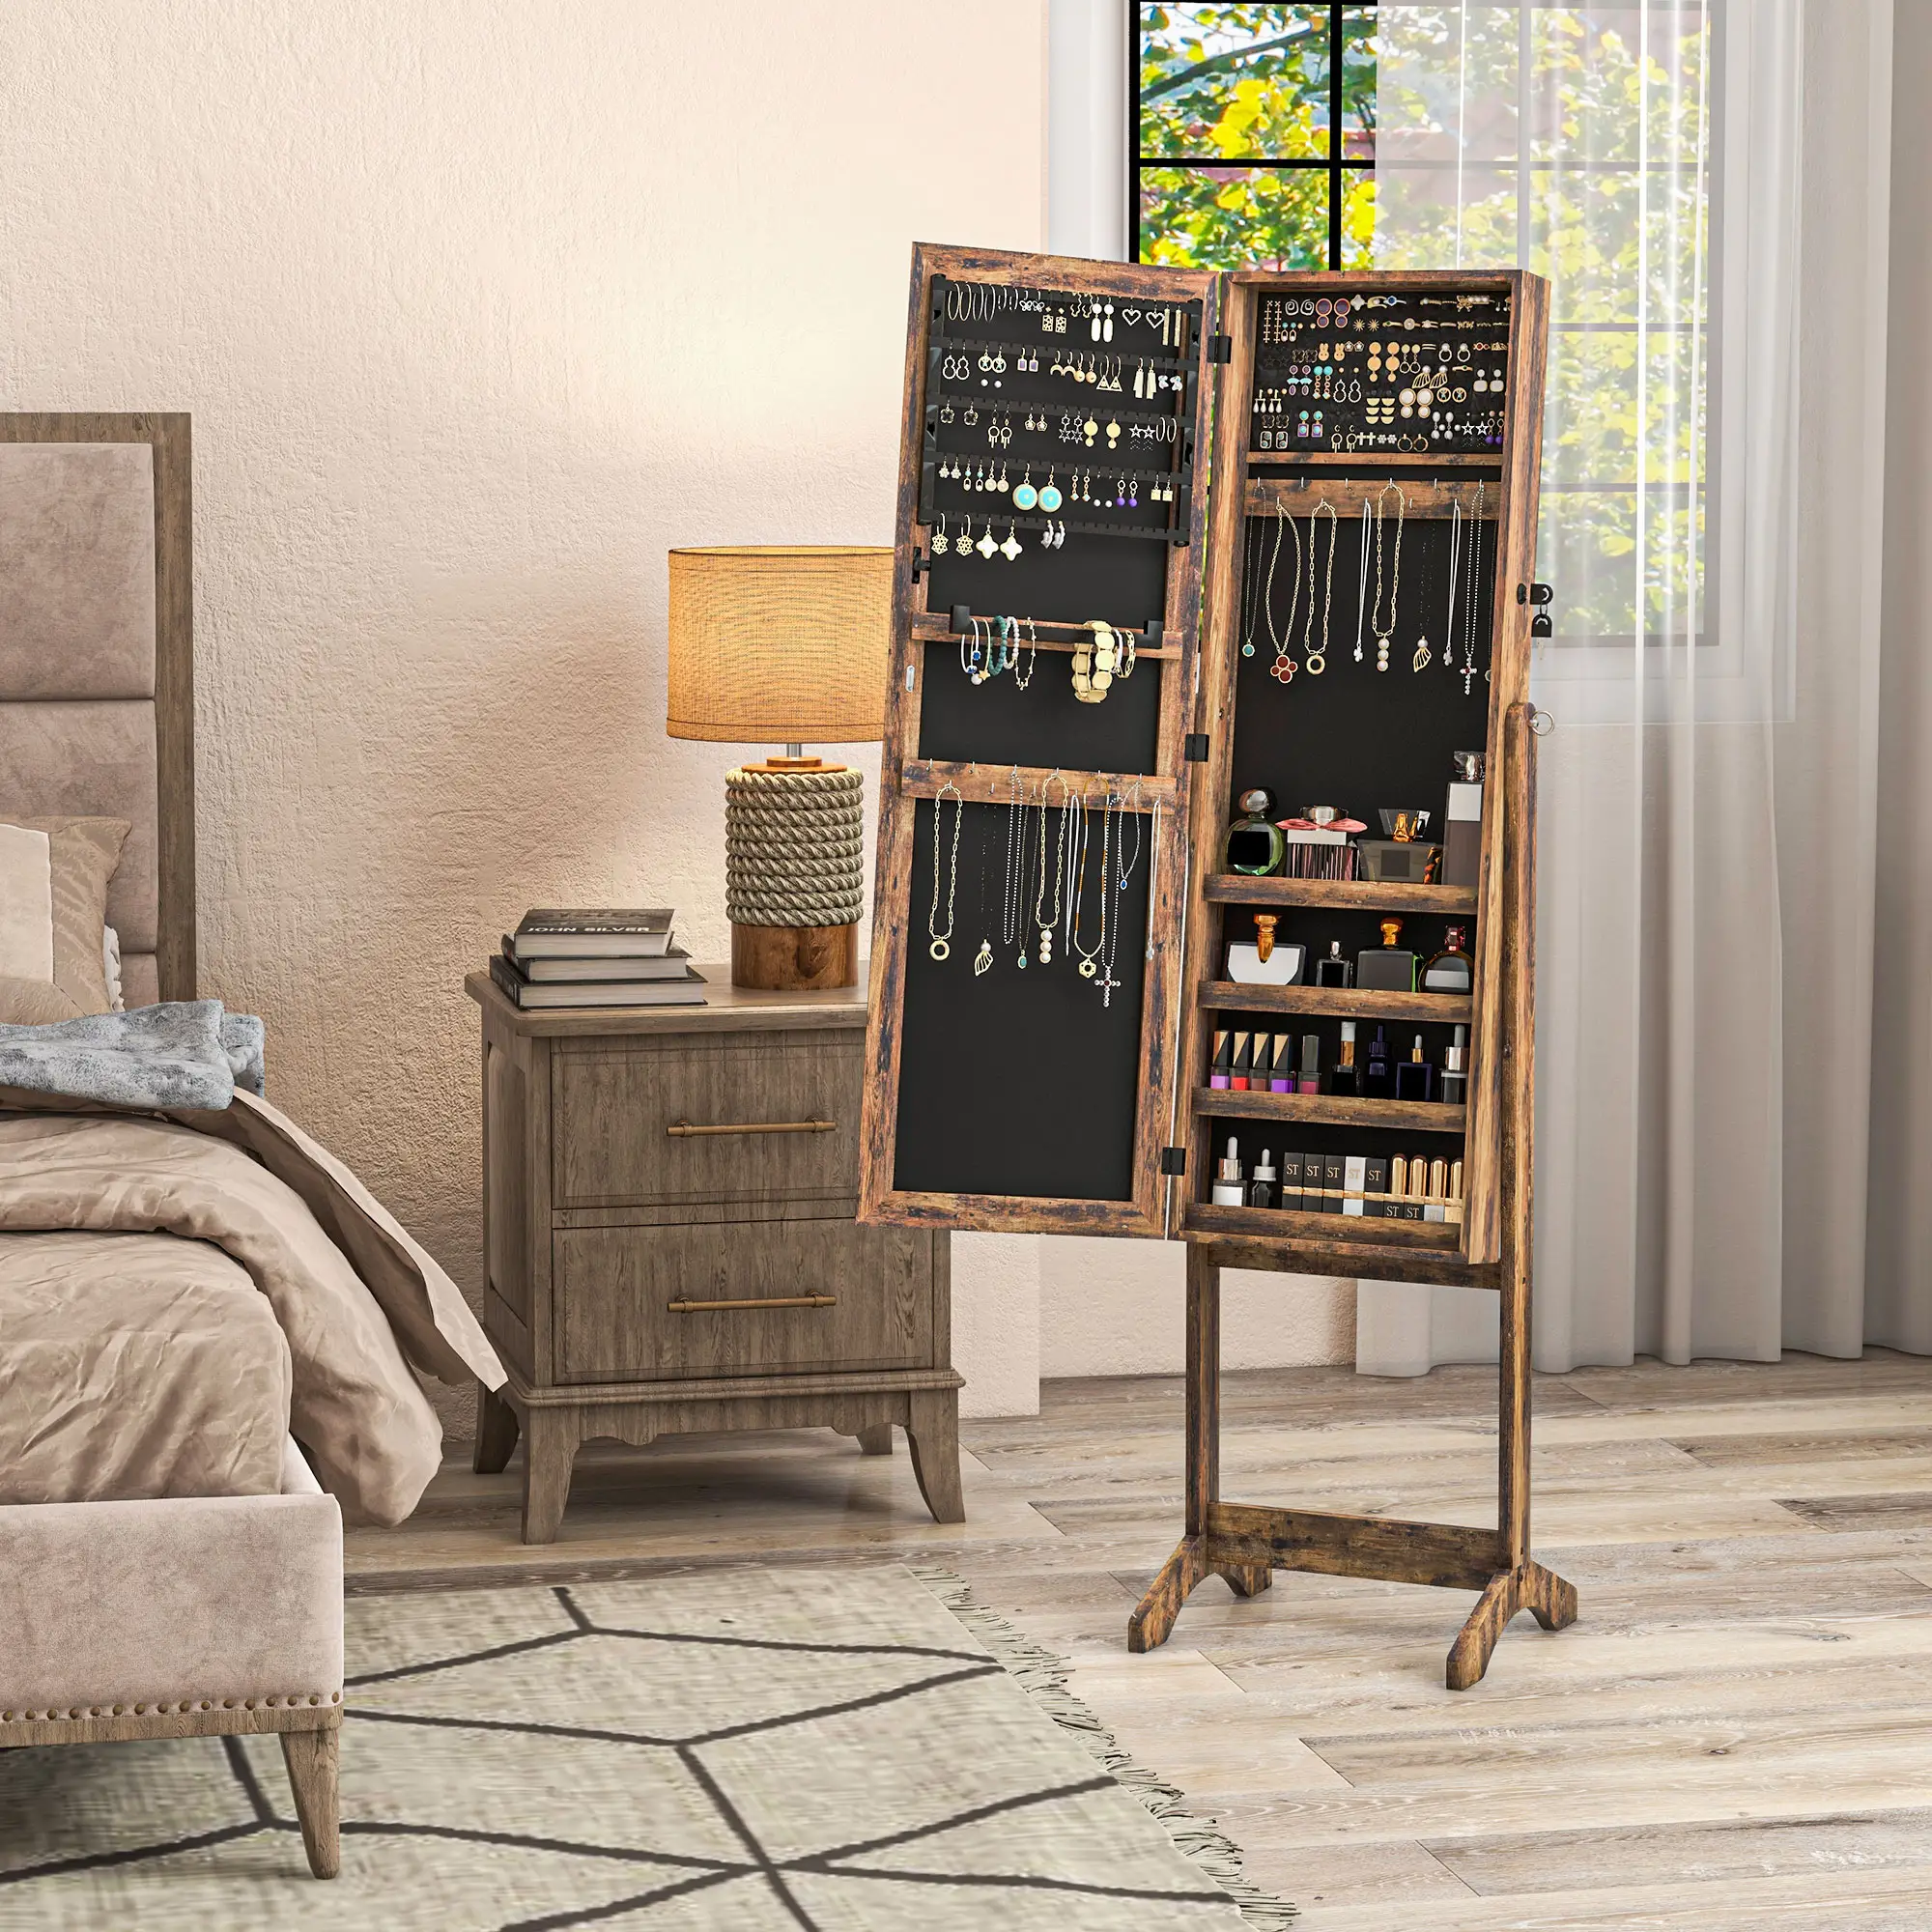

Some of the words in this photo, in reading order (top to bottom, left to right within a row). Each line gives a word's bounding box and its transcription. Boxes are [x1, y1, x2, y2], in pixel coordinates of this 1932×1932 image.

[1287, 1164, 1298, 1175] ST
[1307, 1165, 1319, 1177] ST
[1327, 1167, 1340, 1178] ST
[1349, 1168, 1360, 1179] ST
[1368, 1170, 1380, 1180] ST
[1387, 1206, 1399, 1216] ST
[1407, 1208, 1419, 1218] ST
